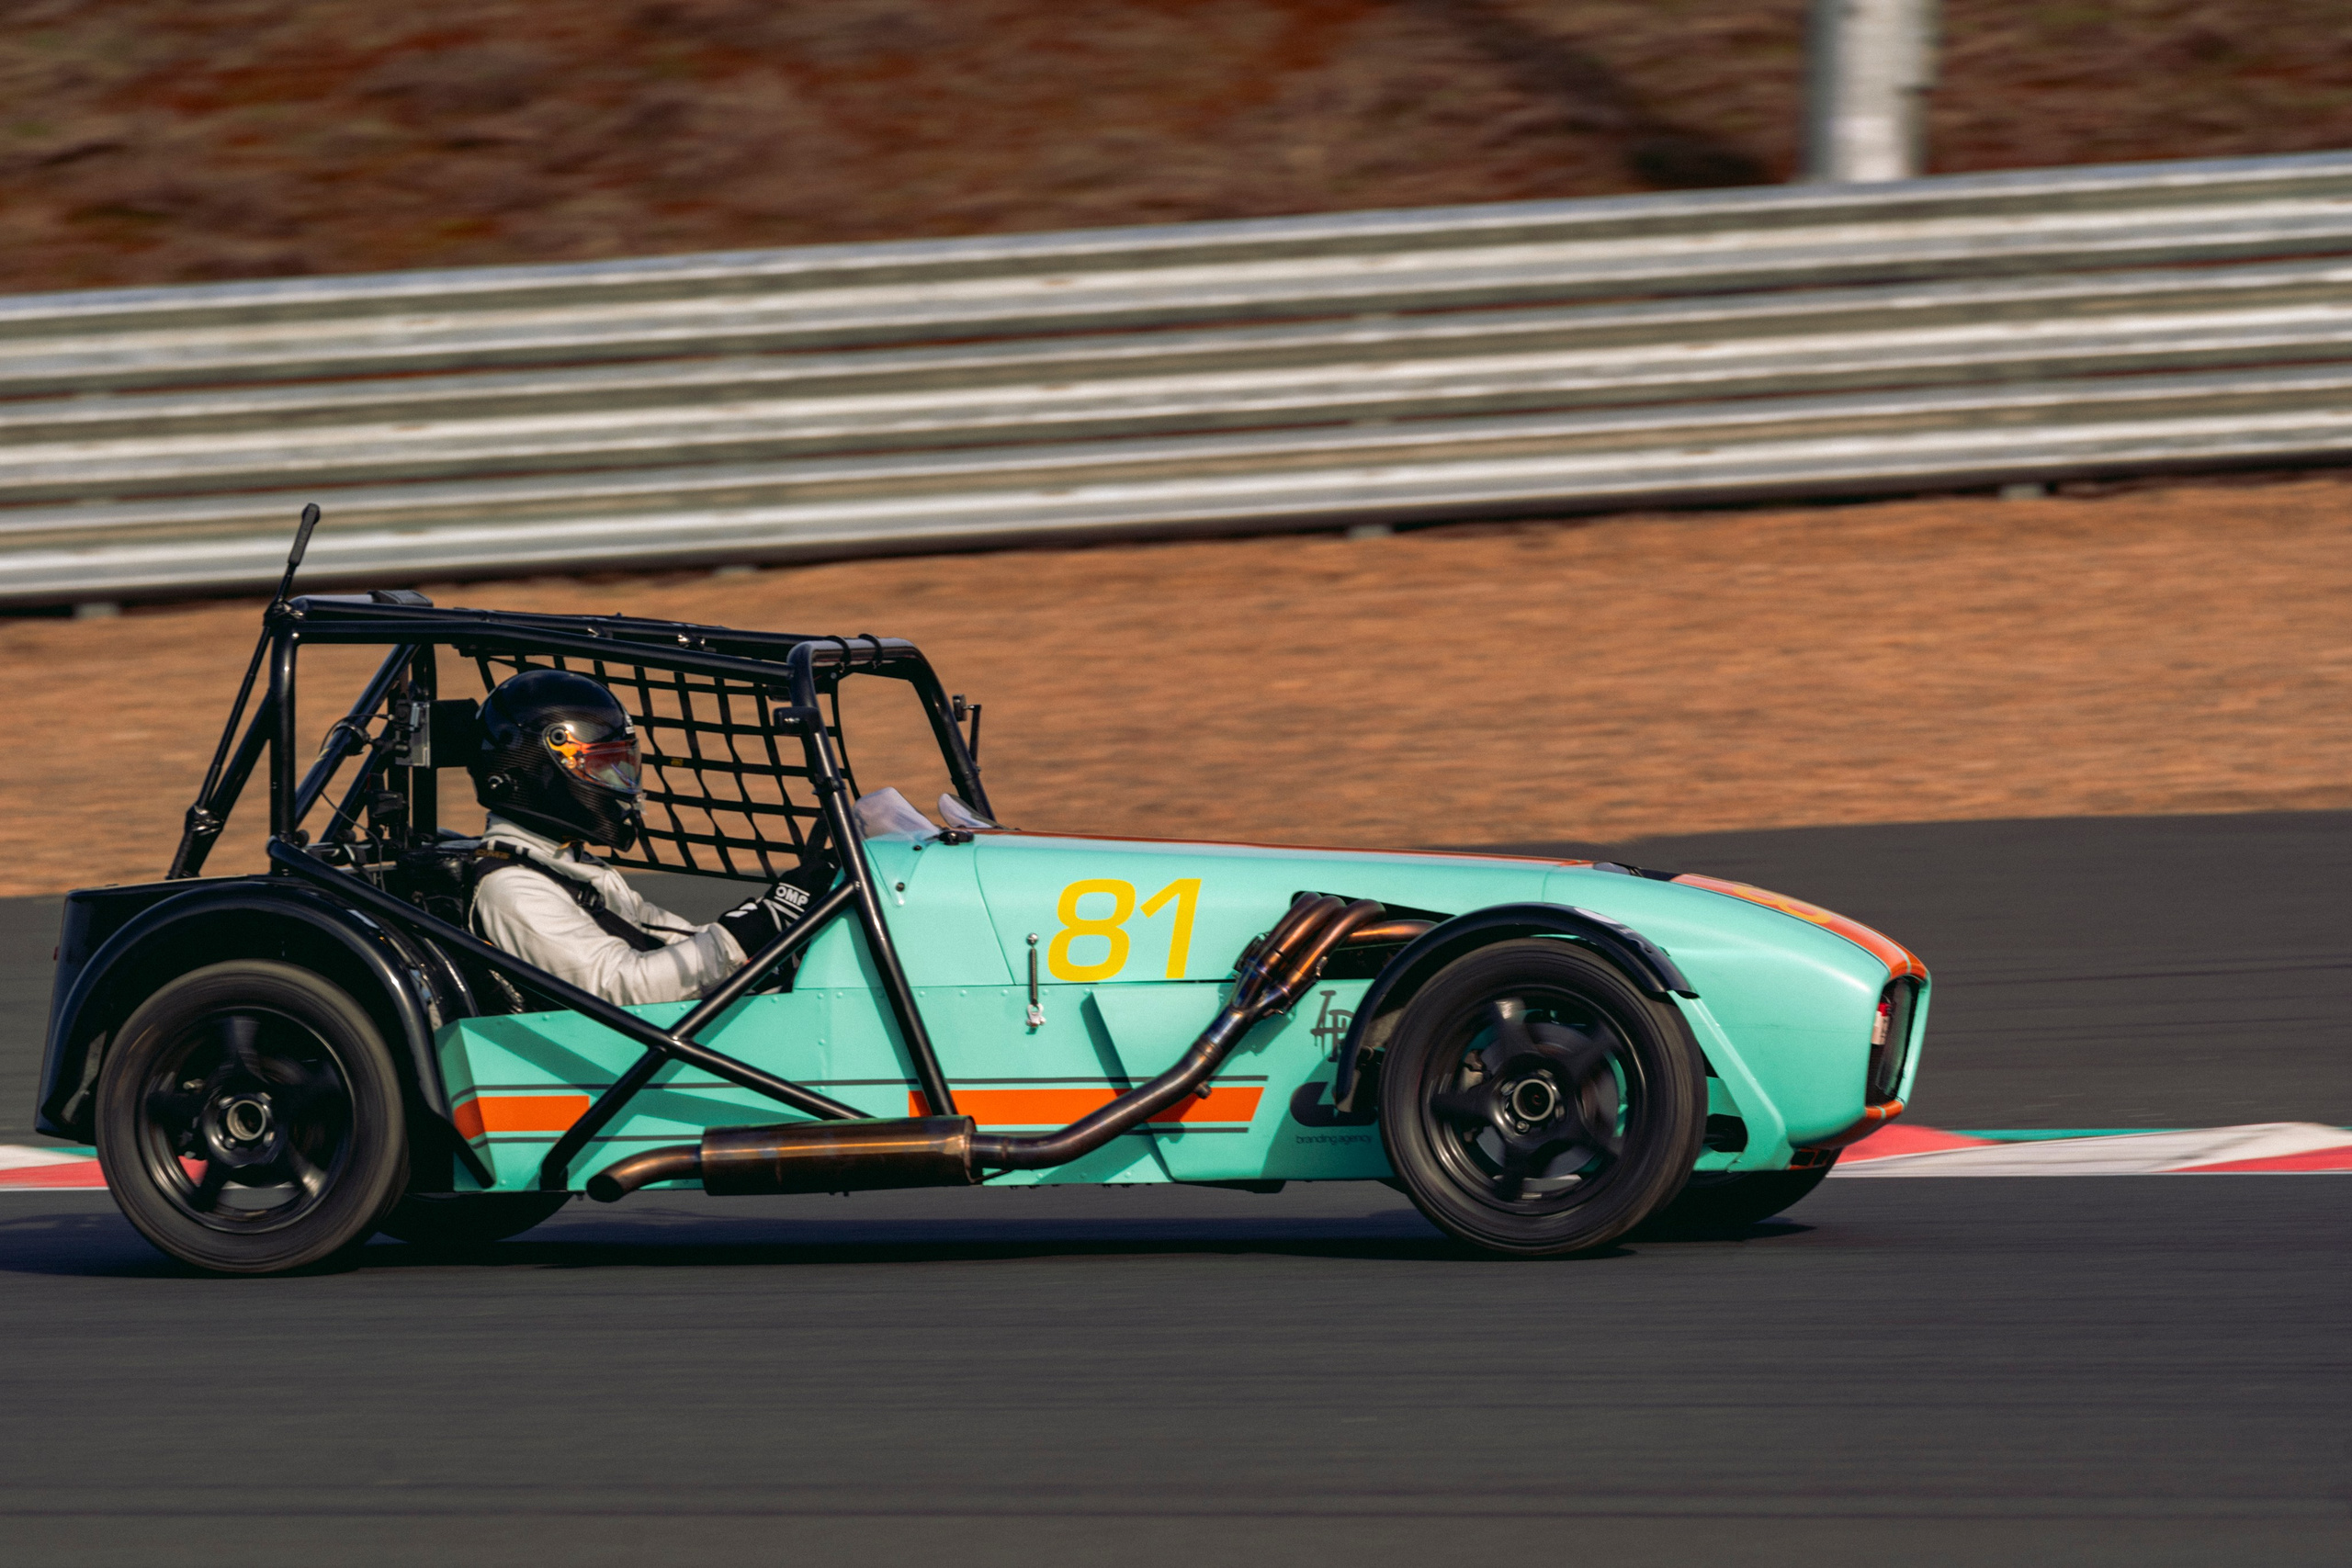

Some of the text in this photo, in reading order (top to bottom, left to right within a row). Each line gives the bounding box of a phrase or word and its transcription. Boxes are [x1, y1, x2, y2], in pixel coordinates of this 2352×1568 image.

[775, 886, 808, 907] OMP
[1047, 878, 1202, 982] 81
[1295, 1134, 1372, 1145] branding agency
